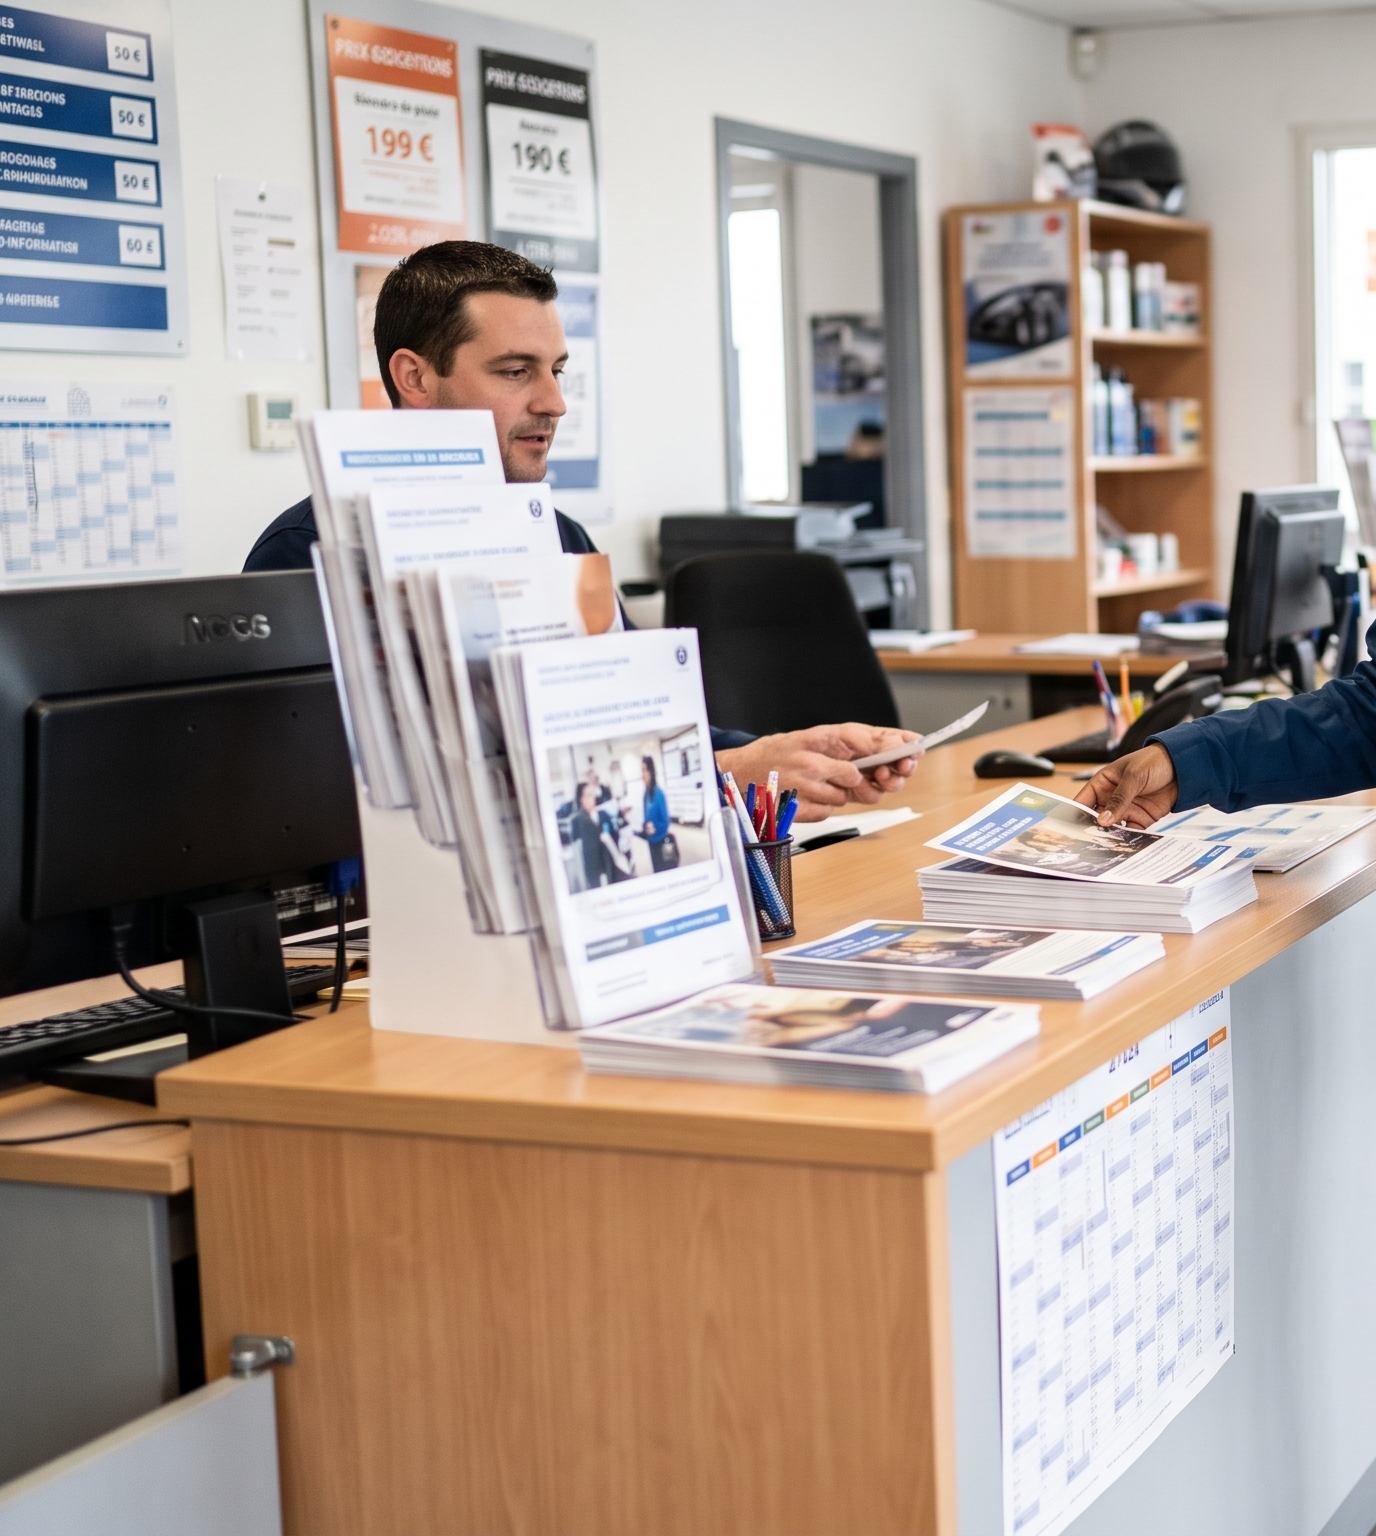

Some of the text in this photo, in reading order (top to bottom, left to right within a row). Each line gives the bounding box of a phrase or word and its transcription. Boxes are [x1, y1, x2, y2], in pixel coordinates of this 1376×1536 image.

[114, 45, 131, 61] 50
[118, 110, 135, 125] 50
[366, 126, 434, 163] 199 €
[511, 142, 572, 176] 190 €
[122, 174, 139, 189] 50
